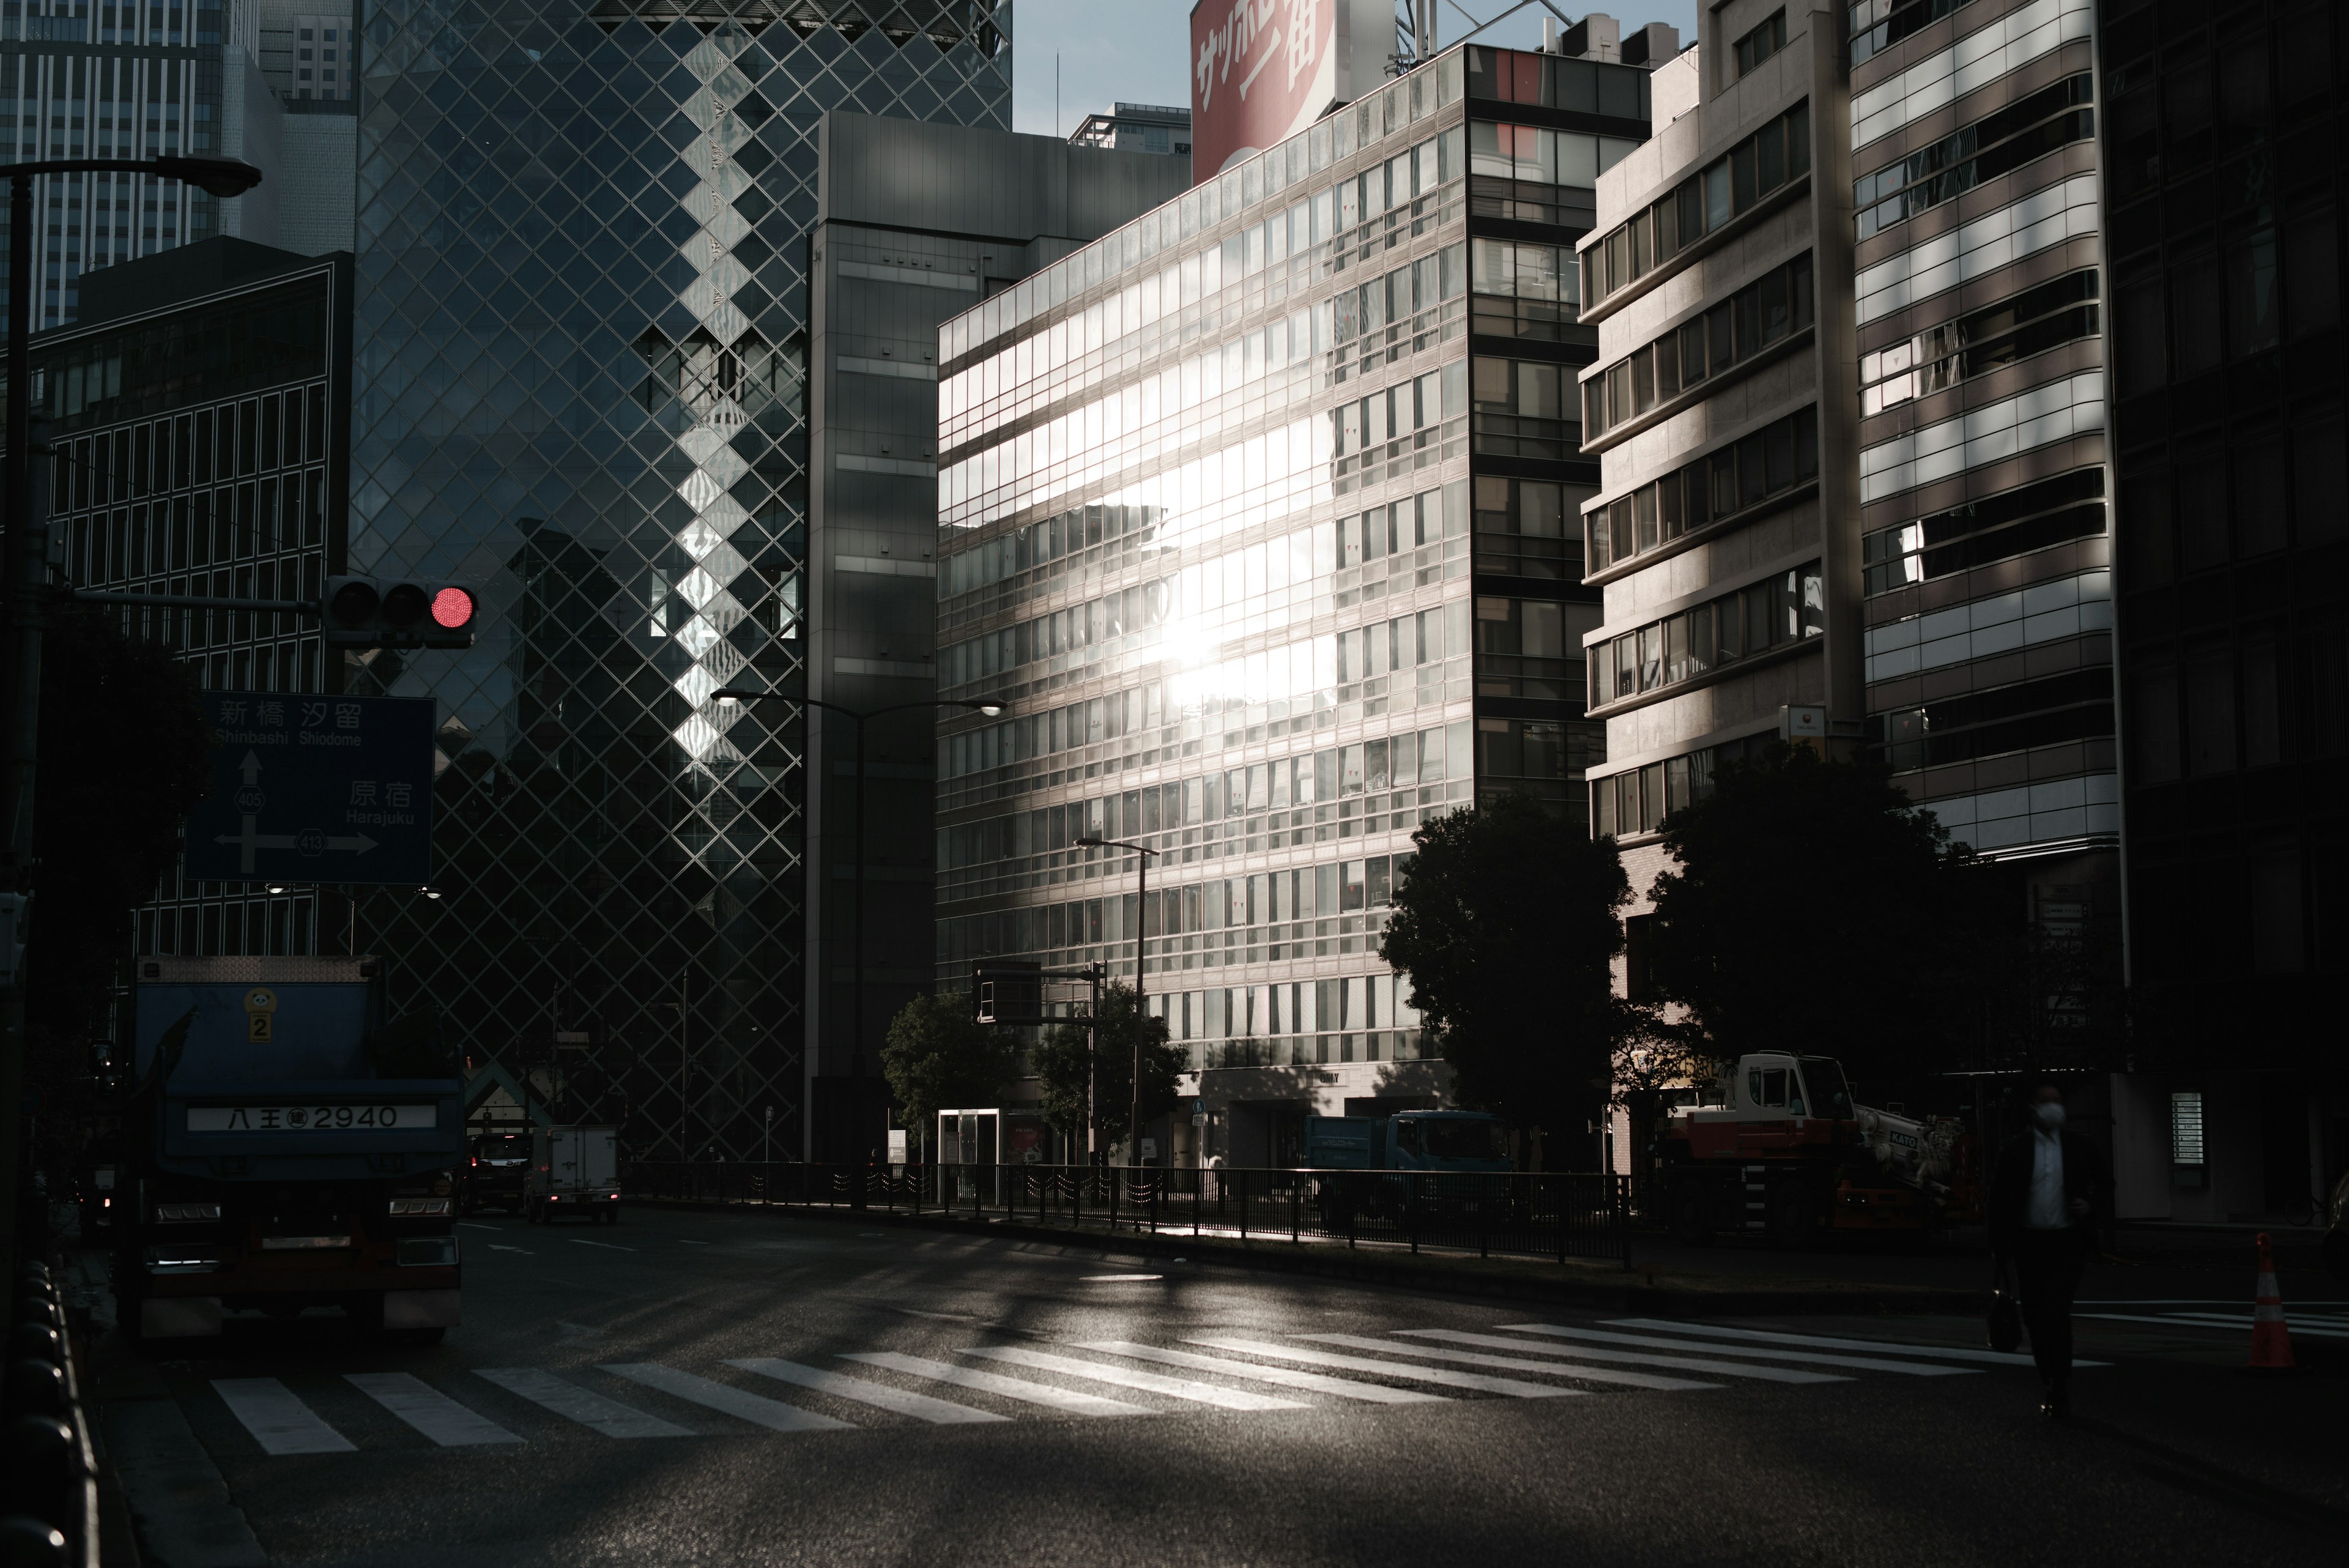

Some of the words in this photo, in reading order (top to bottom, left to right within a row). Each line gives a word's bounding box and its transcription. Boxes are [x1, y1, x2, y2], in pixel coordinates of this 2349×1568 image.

[220, 699, 284, 727] 新橋
[300, 702, 362, 729] 汐留
[215, 729, 289, 745] Shinbashi
[299, 731, 362, 747] Shiodome
[237, 793, 261, 807] 405
[349, 780, 412, 808] 原宿
[346, 809, 414, 827] Harajuku
[300, 836, 322, 850] 413
[253, 1018, 267, 1036] 2
[314, 1106, 397, 1128] 2940
[1892, 1132, 1918, 1148] KATO
